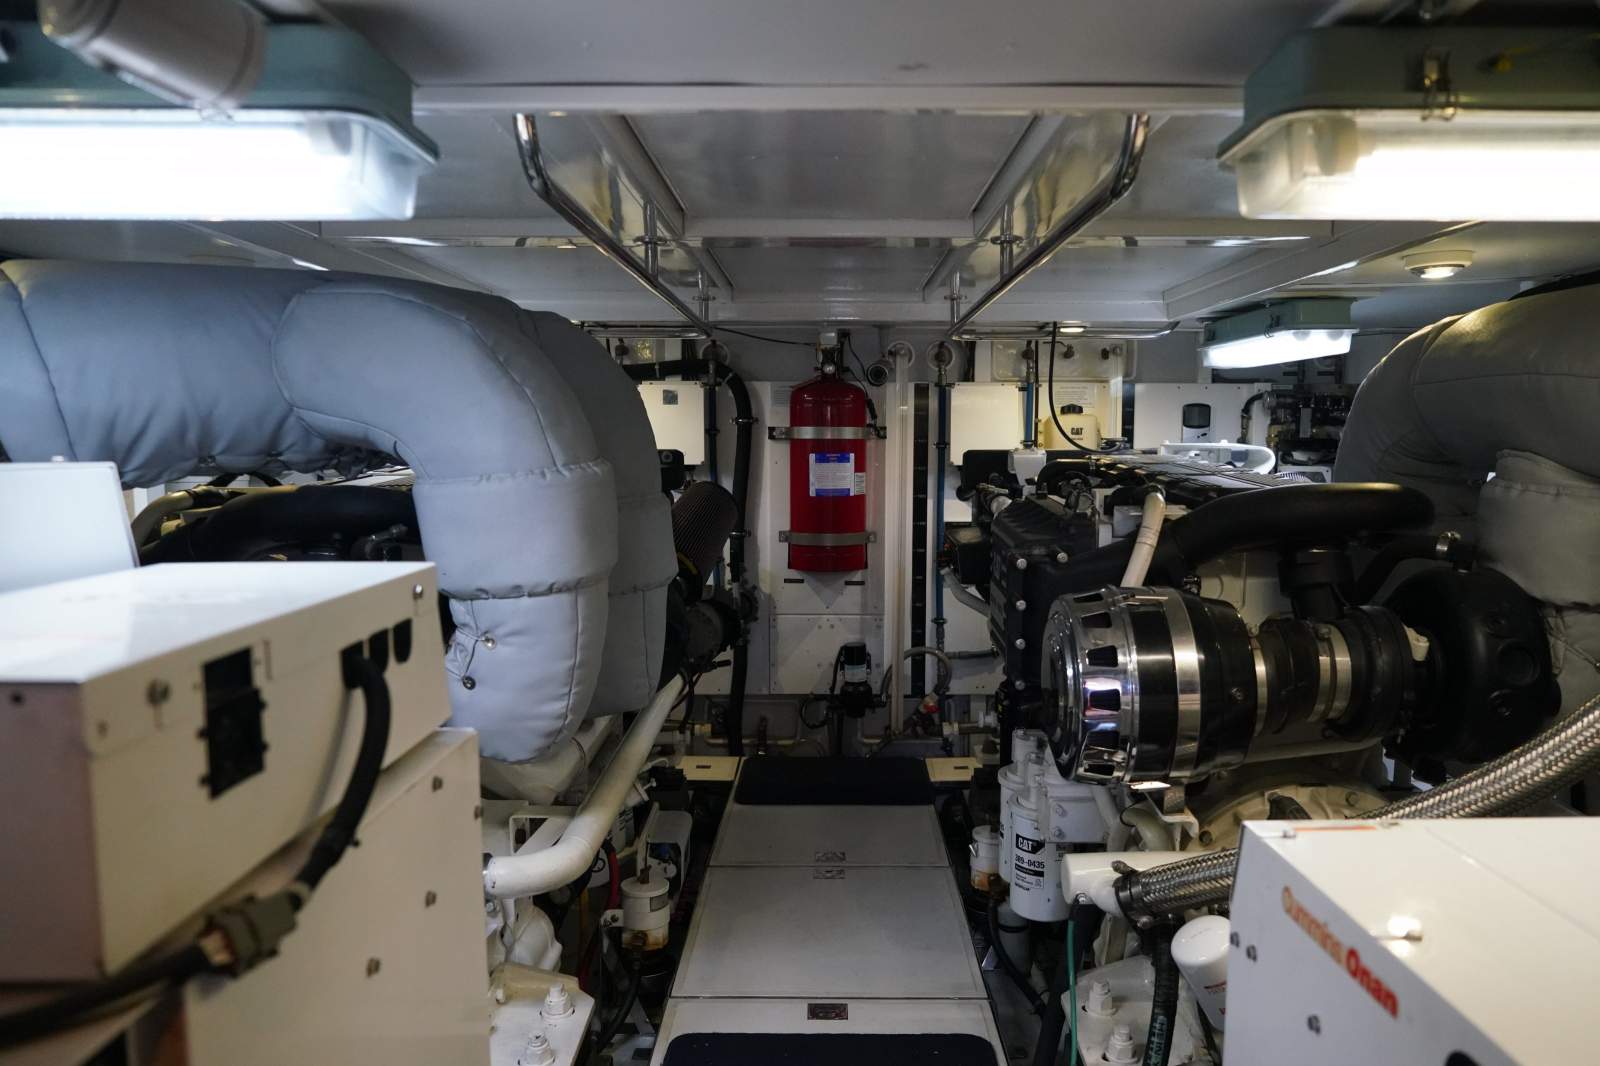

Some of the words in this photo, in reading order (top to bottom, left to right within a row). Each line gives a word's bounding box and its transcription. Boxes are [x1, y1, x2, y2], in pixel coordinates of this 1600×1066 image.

[1071, 427, 1083, 435] CAT
[1018, 837, 1033, 851] CAT
[1345, 947, 1398, 1020] Onan
